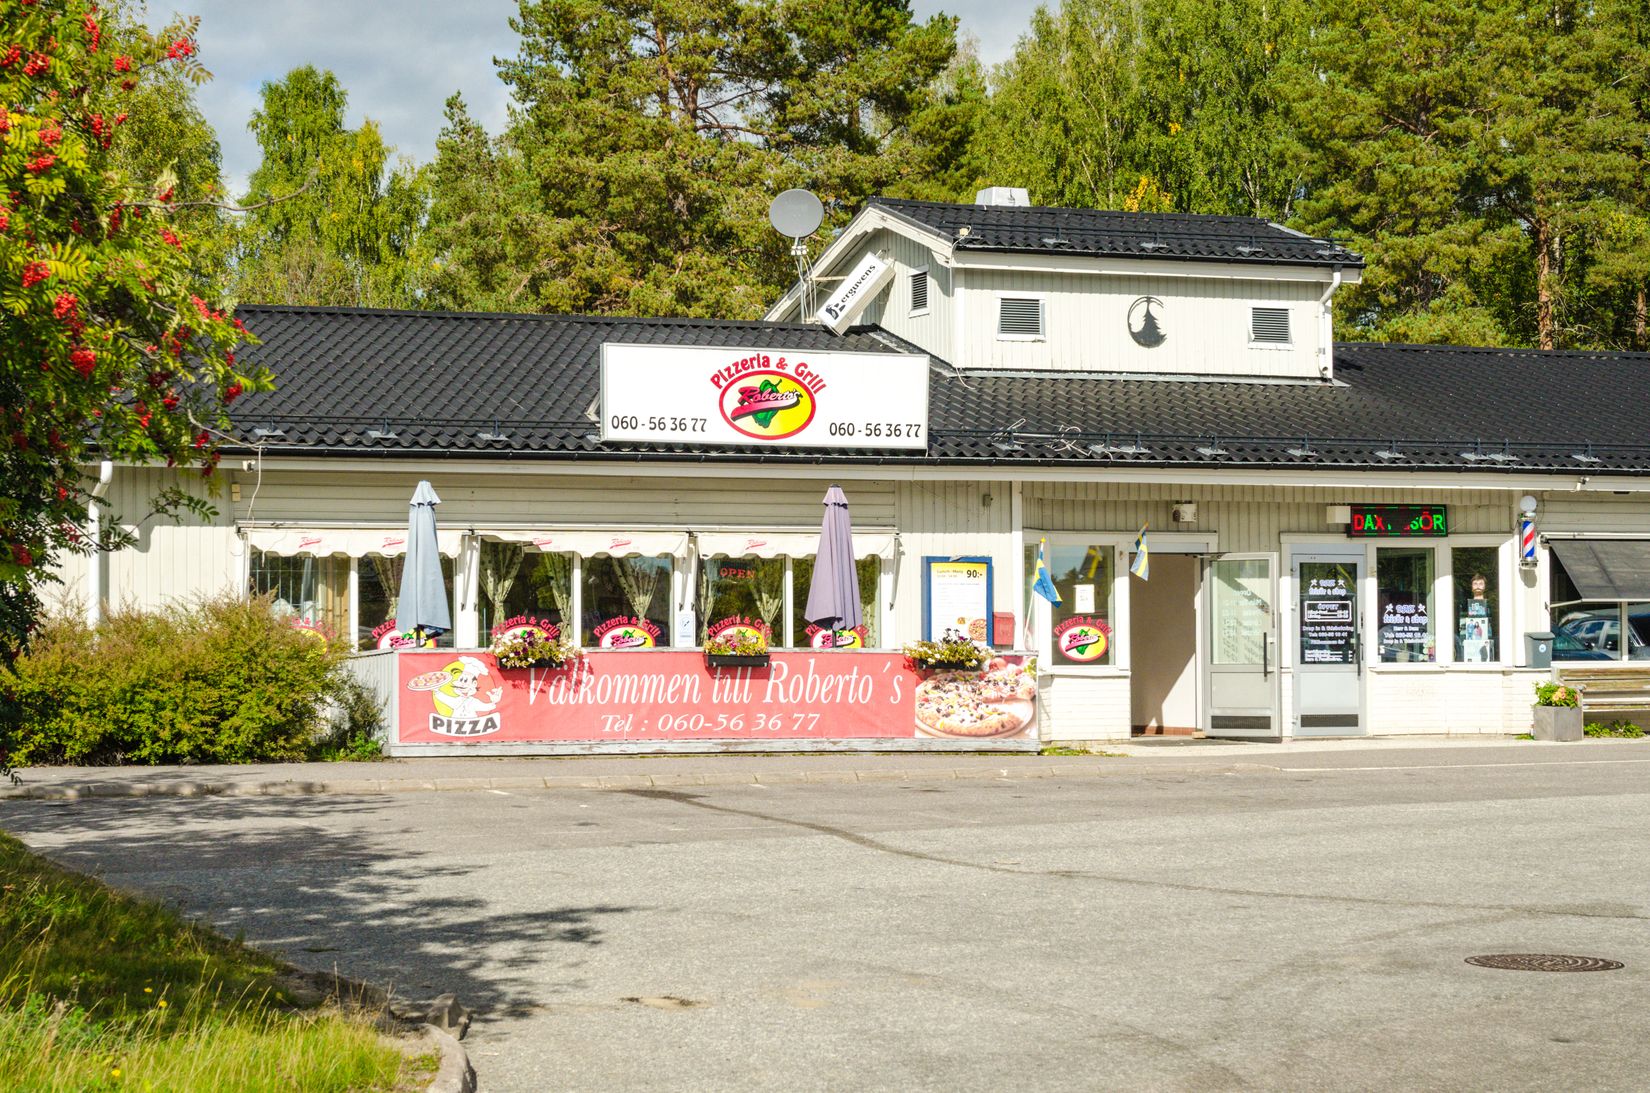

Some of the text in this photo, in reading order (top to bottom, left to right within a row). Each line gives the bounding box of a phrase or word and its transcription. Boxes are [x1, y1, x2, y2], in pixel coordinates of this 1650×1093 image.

[710, 353, 827, 395] Pizzeria & Grill
[737, 385, 803, 405] Roberto's
[611, 415, 638, 430] 060
[649, 416, 666, 431] 56
[670, 417, 687, 432] 36
[691, 418, 707, 433] 77
[829, 422, 855, 437] 060
[865, 422, 882, 437] 56
[885, 423, 902, 437] 36
[905, 423, 921, 438] 77
[1353, 514, 1385, 530] DAX
[720, 567, 756, 579] OPEN
[529, 616, 537, 625] &
[593, 615, 629, 638] Pizzeria
[630, 616, 638, 625] &
[743, 616, 751, 625] &
[1054, 616, 1084, 636] Pizzeria
[712, 667, 753, 704] till
[432, 715, 498, 735] PIZZA
[600, 713, 633, 732] Tel
[657, 713, 745, 732] 060-56
[752, 713, 783, 732] 36
[791, 713, 821, 731] 77
